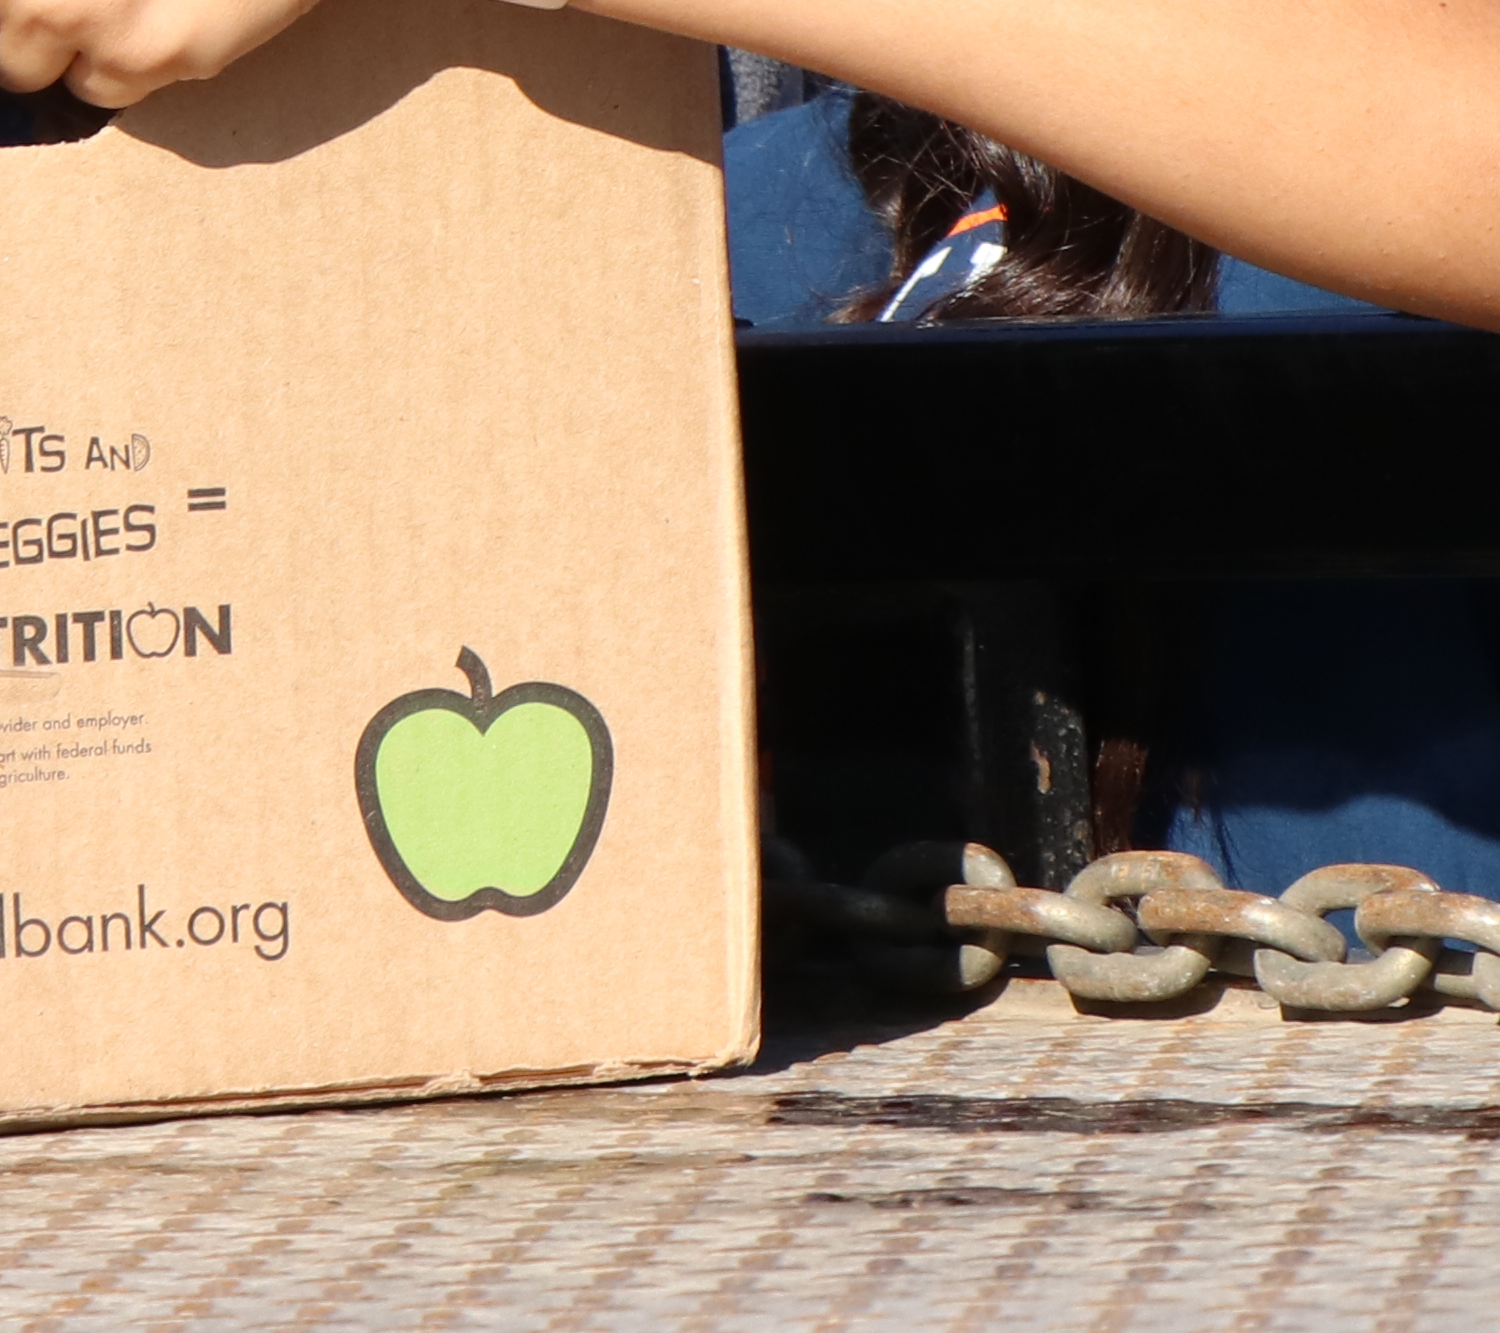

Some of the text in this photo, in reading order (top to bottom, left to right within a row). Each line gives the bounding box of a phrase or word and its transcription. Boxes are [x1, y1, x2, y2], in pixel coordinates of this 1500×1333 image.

[42, 713, 72, 731] and
[76, 710, 149, 732] employer.
[20, 743, 51, 761] with
[56, 739, 109, 760] federal
[112, 736, 153, 754] funds
